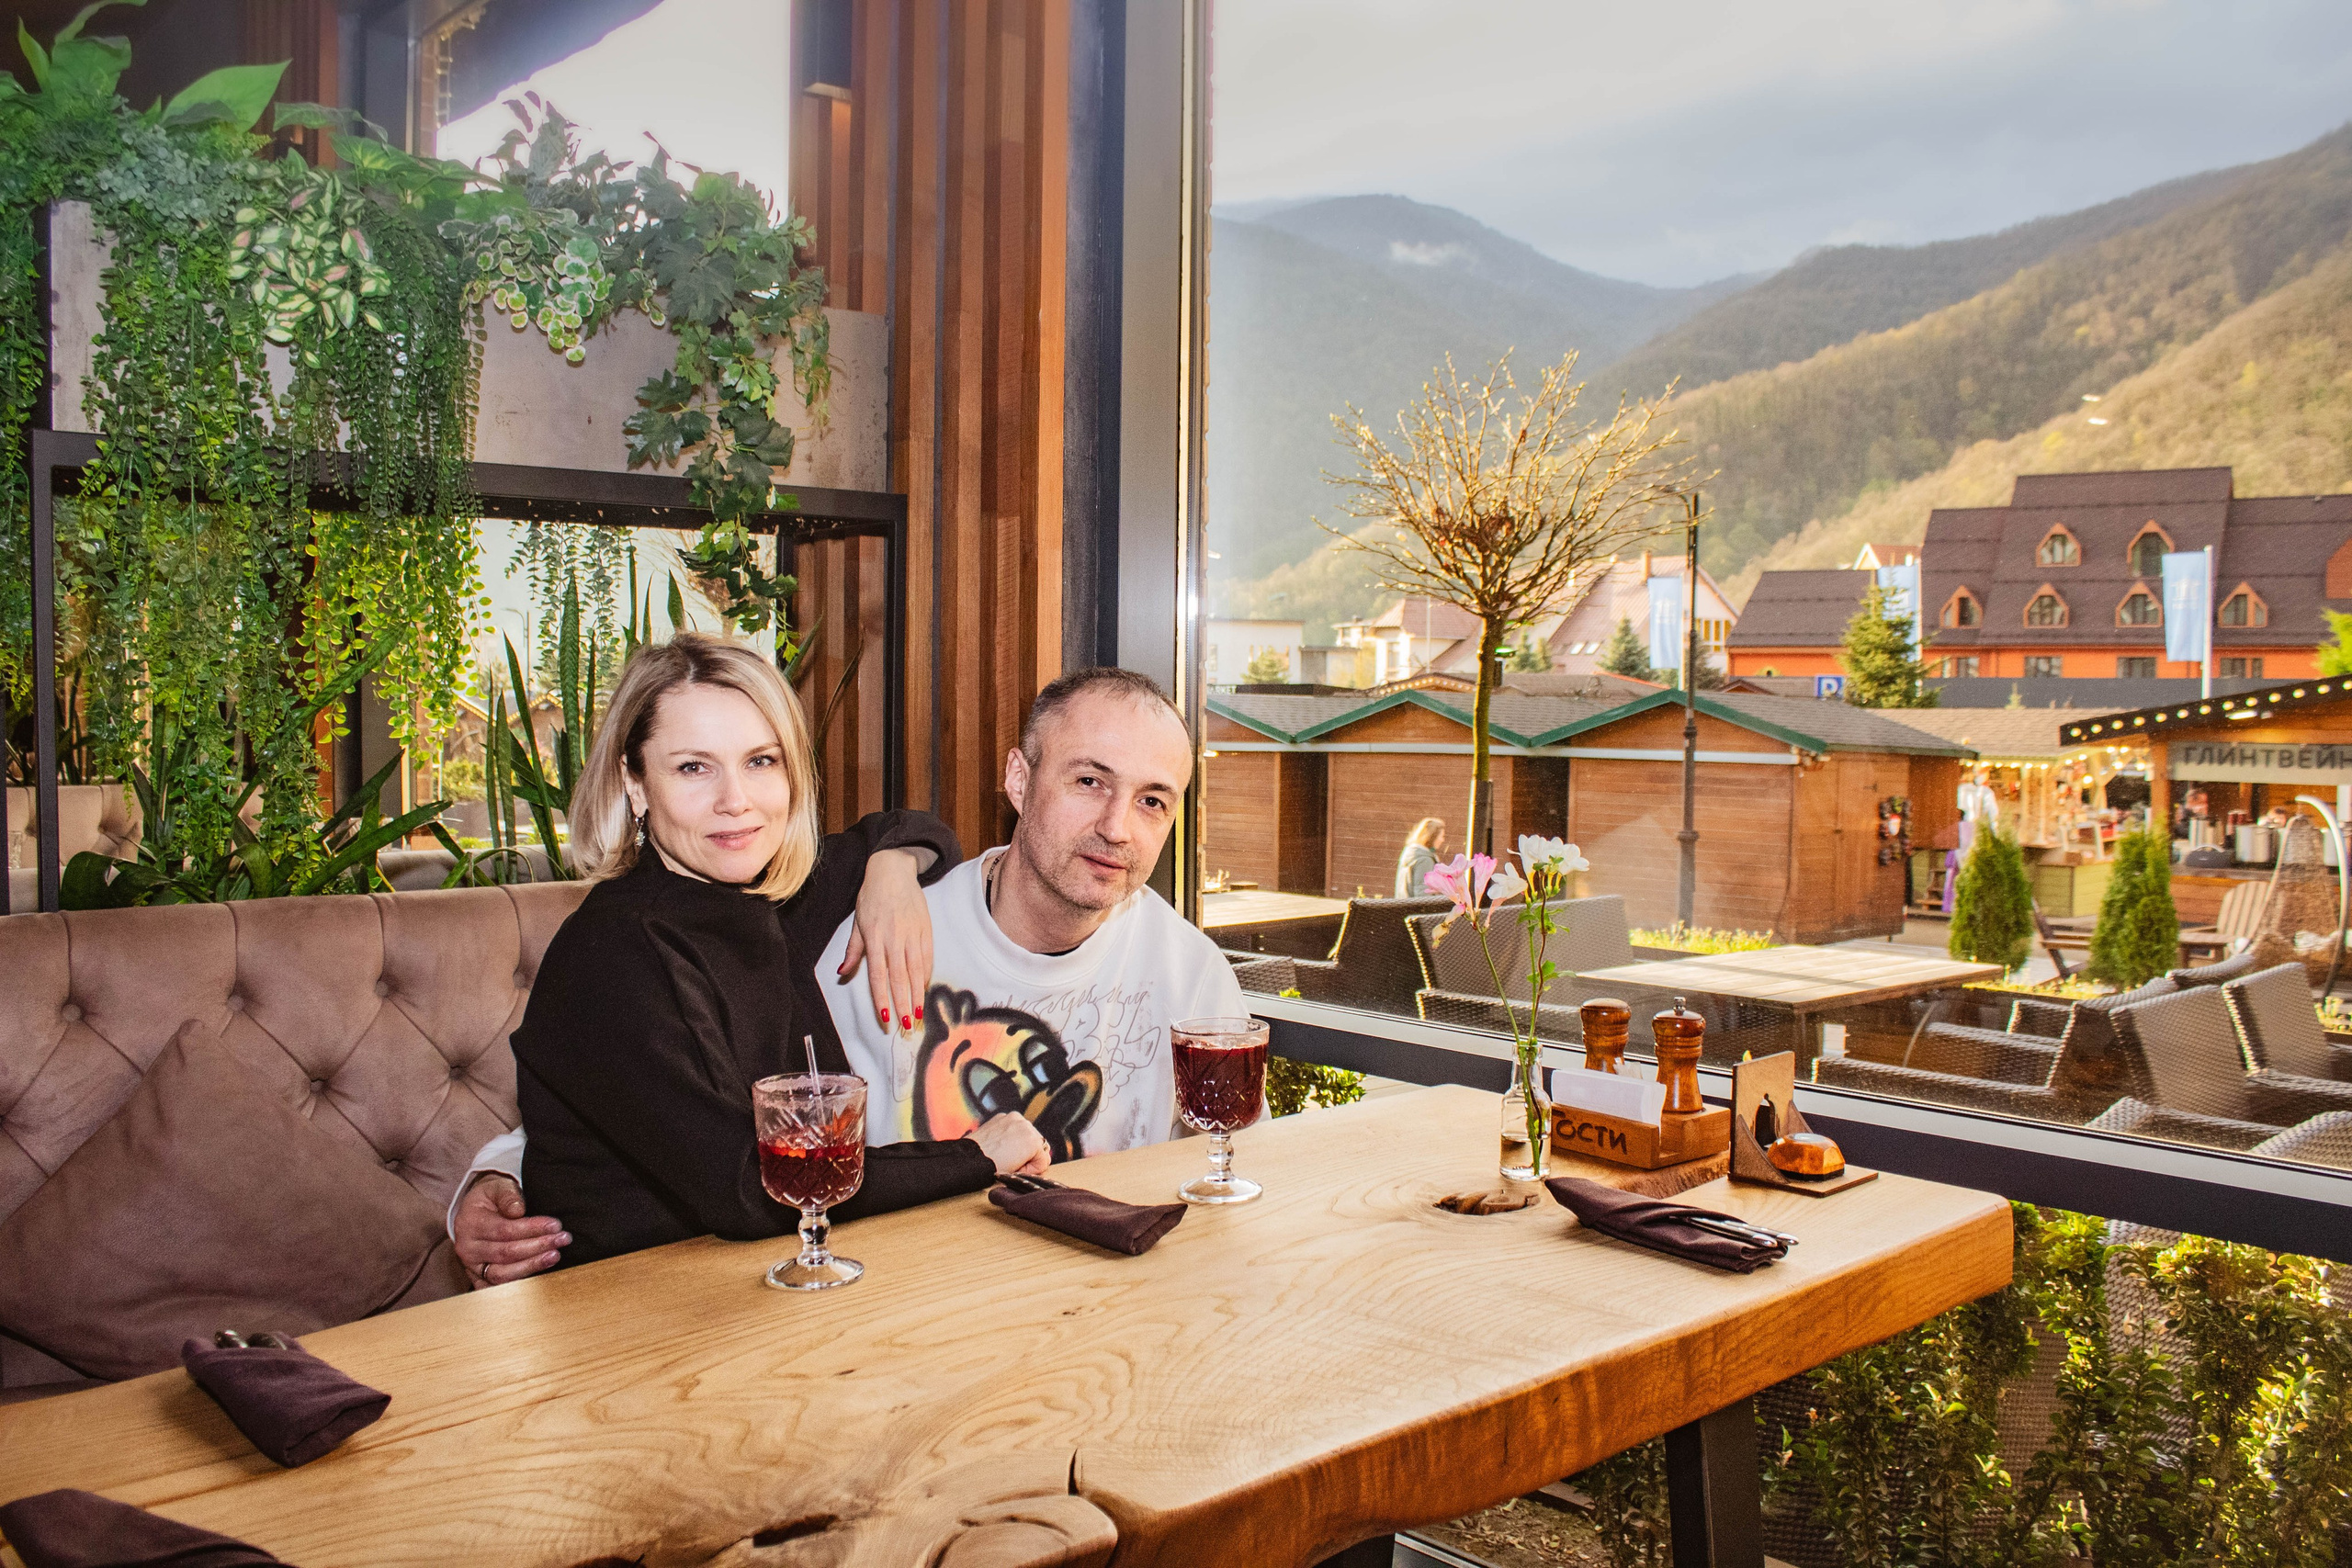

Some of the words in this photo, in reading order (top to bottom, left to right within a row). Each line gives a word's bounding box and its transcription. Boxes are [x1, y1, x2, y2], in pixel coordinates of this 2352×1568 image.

[1206, 685, 1236, 695] ARKET
[1821, 679, 1838, 697] P
[2184, 745, 2352, 769] ГЛИНТВЕЙН
